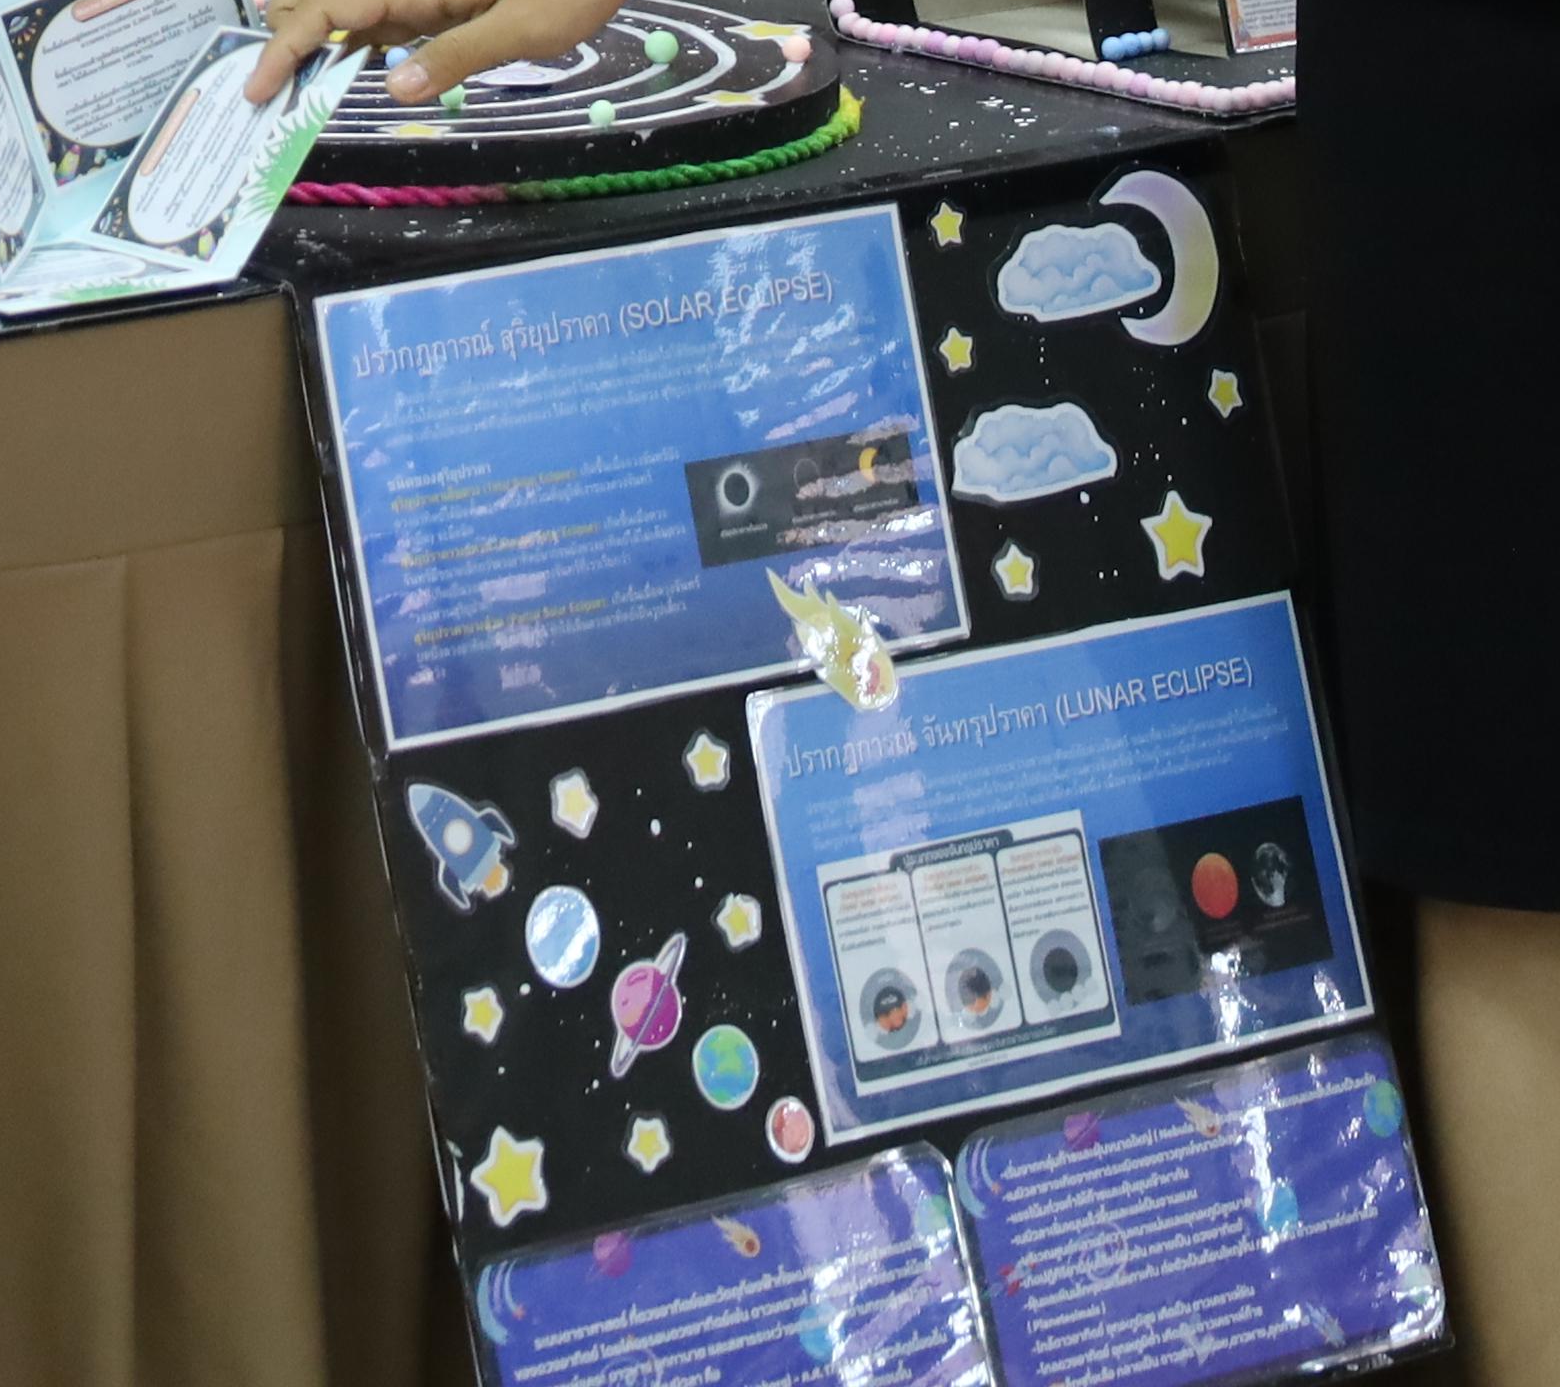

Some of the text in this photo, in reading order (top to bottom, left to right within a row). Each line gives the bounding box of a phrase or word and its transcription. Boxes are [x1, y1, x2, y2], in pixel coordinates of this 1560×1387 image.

[499, 313, 611, 361] สุริยุปราคา
[618, 291, 714, 337] (SOLAR
[722, 271, 834, 318] ECLIPSE)
[786, 659, 1254, 779] ปรากฏการณ์ จันทรุปราคา (LUNAR ECLIPSE)
